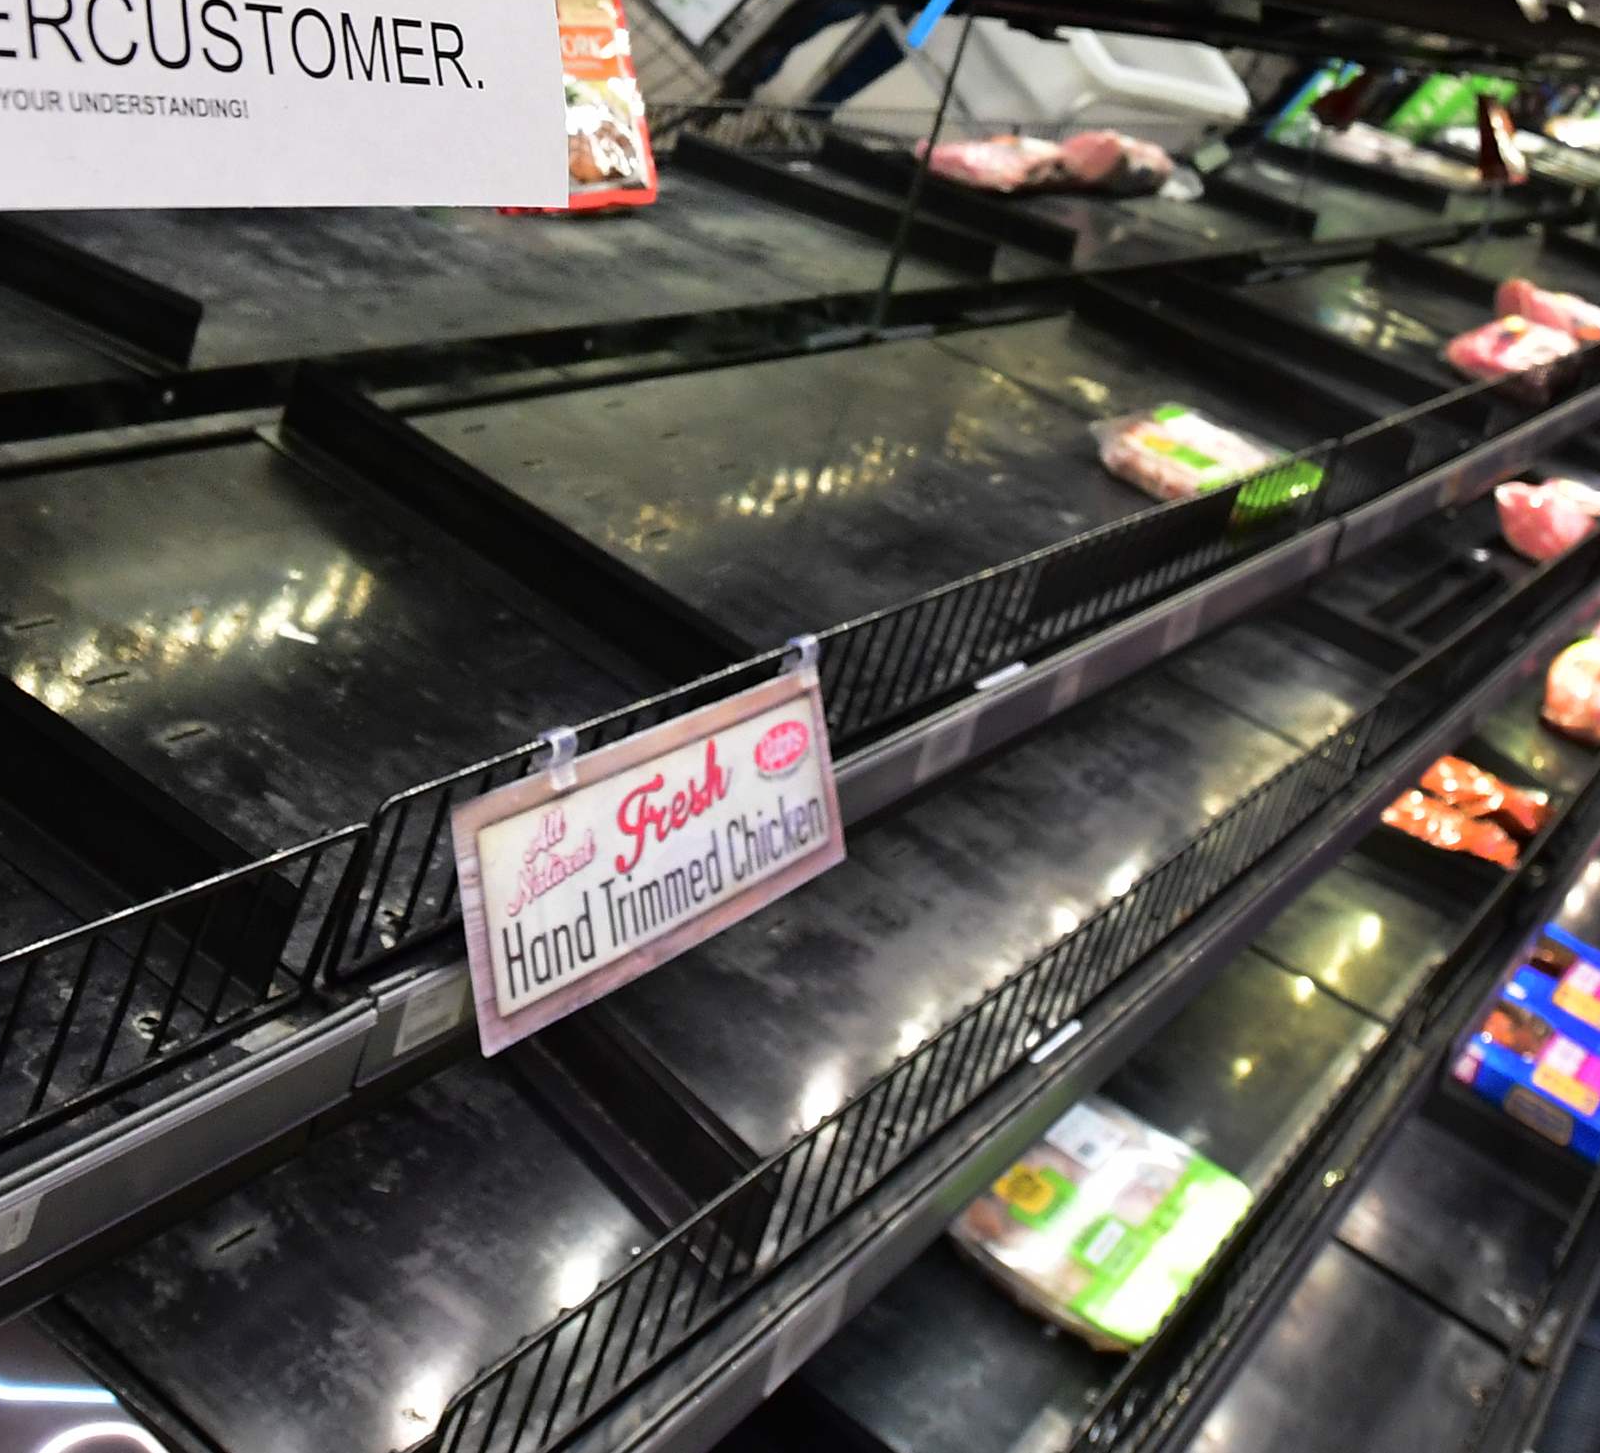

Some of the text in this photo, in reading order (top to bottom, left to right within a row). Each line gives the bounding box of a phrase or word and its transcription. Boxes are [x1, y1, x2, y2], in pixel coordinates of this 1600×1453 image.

[69, 92, 249, 119] UNDERSTANDING!
[615, 739, 729, 874] Fresh
[502, 794, 825, 1000] Hand Trimmed Chicken
